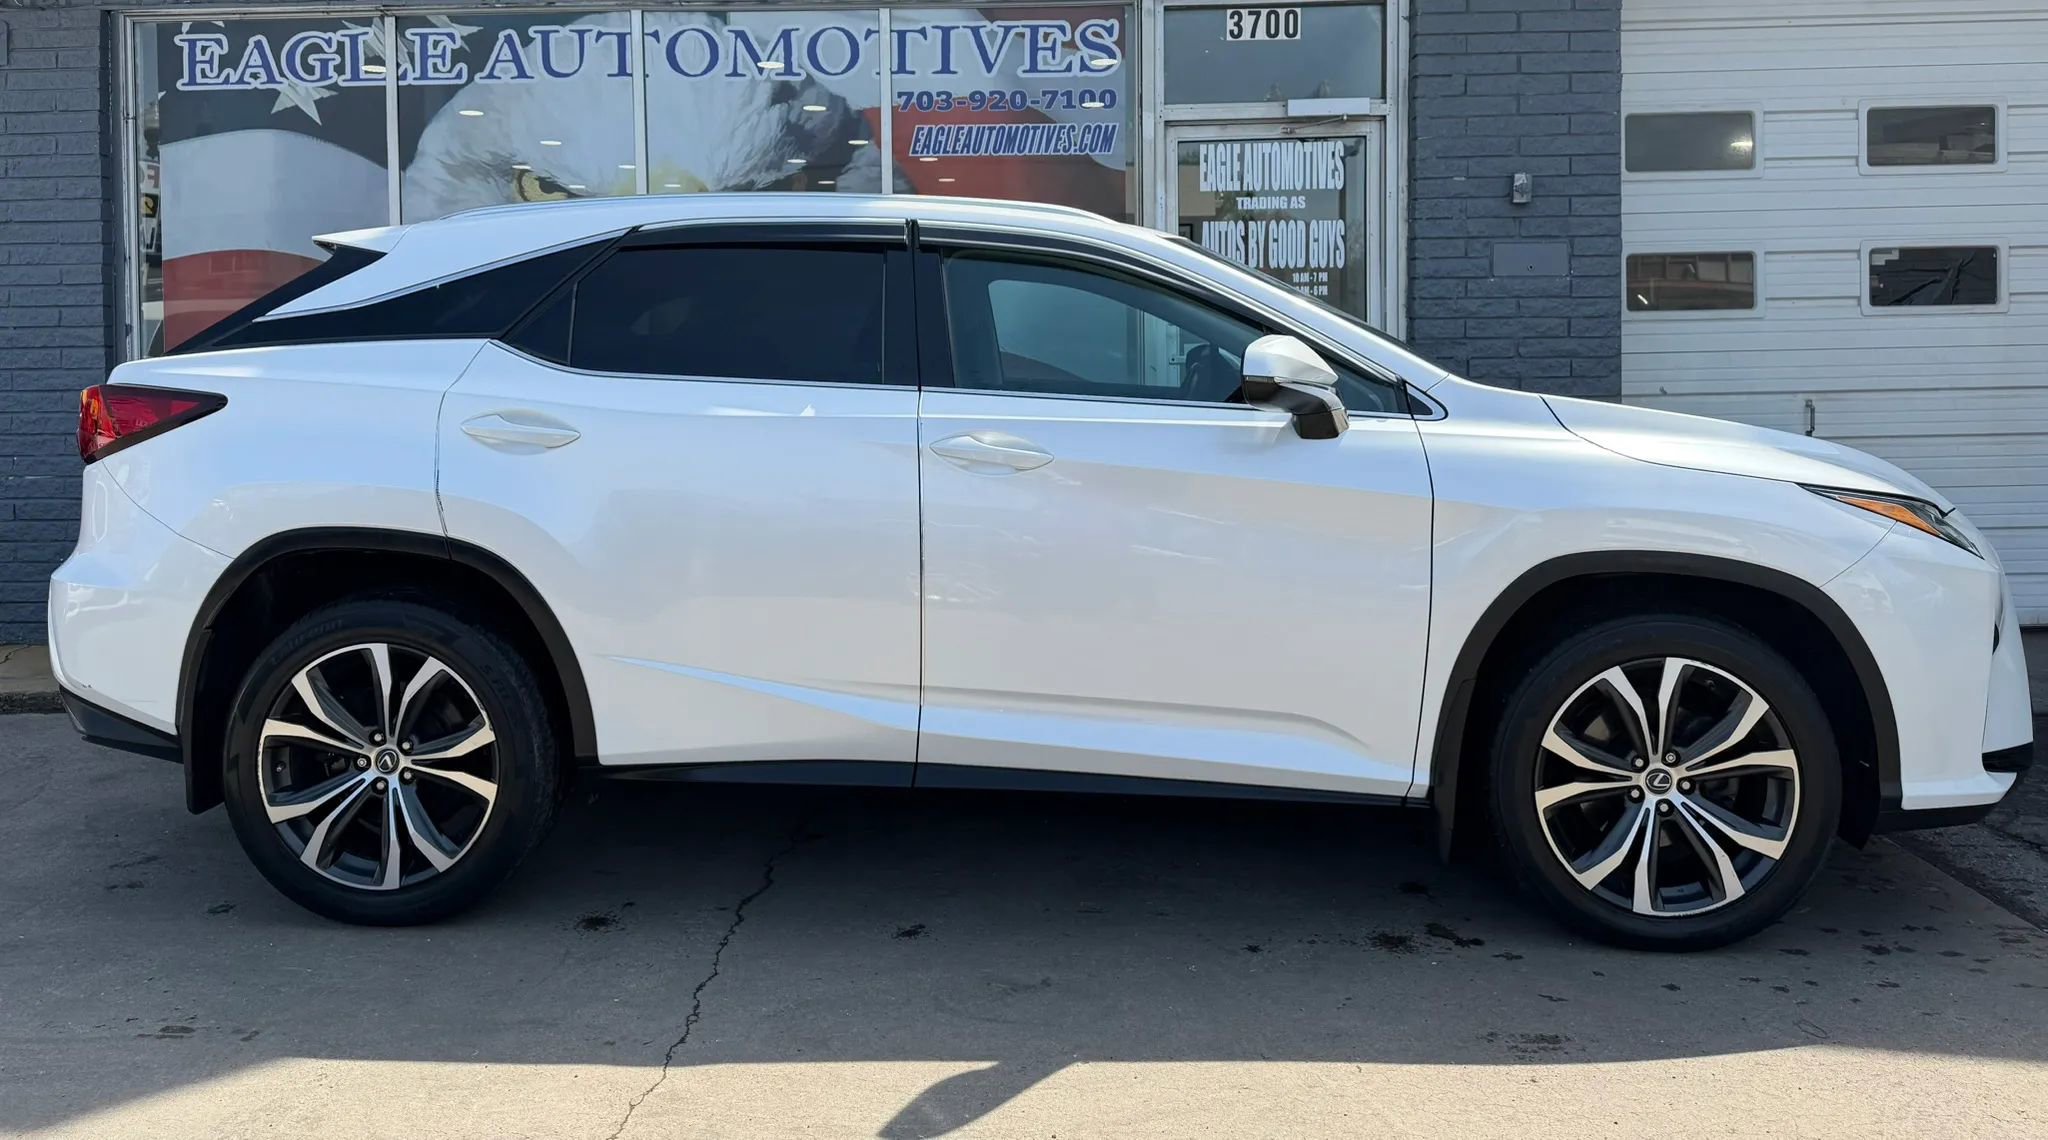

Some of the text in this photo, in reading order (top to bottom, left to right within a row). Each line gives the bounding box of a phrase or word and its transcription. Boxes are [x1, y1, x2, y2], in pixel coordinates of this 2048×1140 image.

[1229, 9, 1299, 39] 3700
[175, 20, 1122, 90] EAGLE AUTOMOTIVES
[896, 88, 1118, 112] 703-920-7100
[909, 123, 1118, 156] EAGLEAUTOMOTIVES.COM
[1199, 140, 1345, 192] EAGLE AUTOMOTIVES
[1236, 195, 1306, 210] TRADING AS
[1248, 220, 1267, 268] BY
[1268, 219, 1306, 269] GOOD
[1309, 218, 1346, 269] GUYS
[1318, 271, 1328, 282] PM
